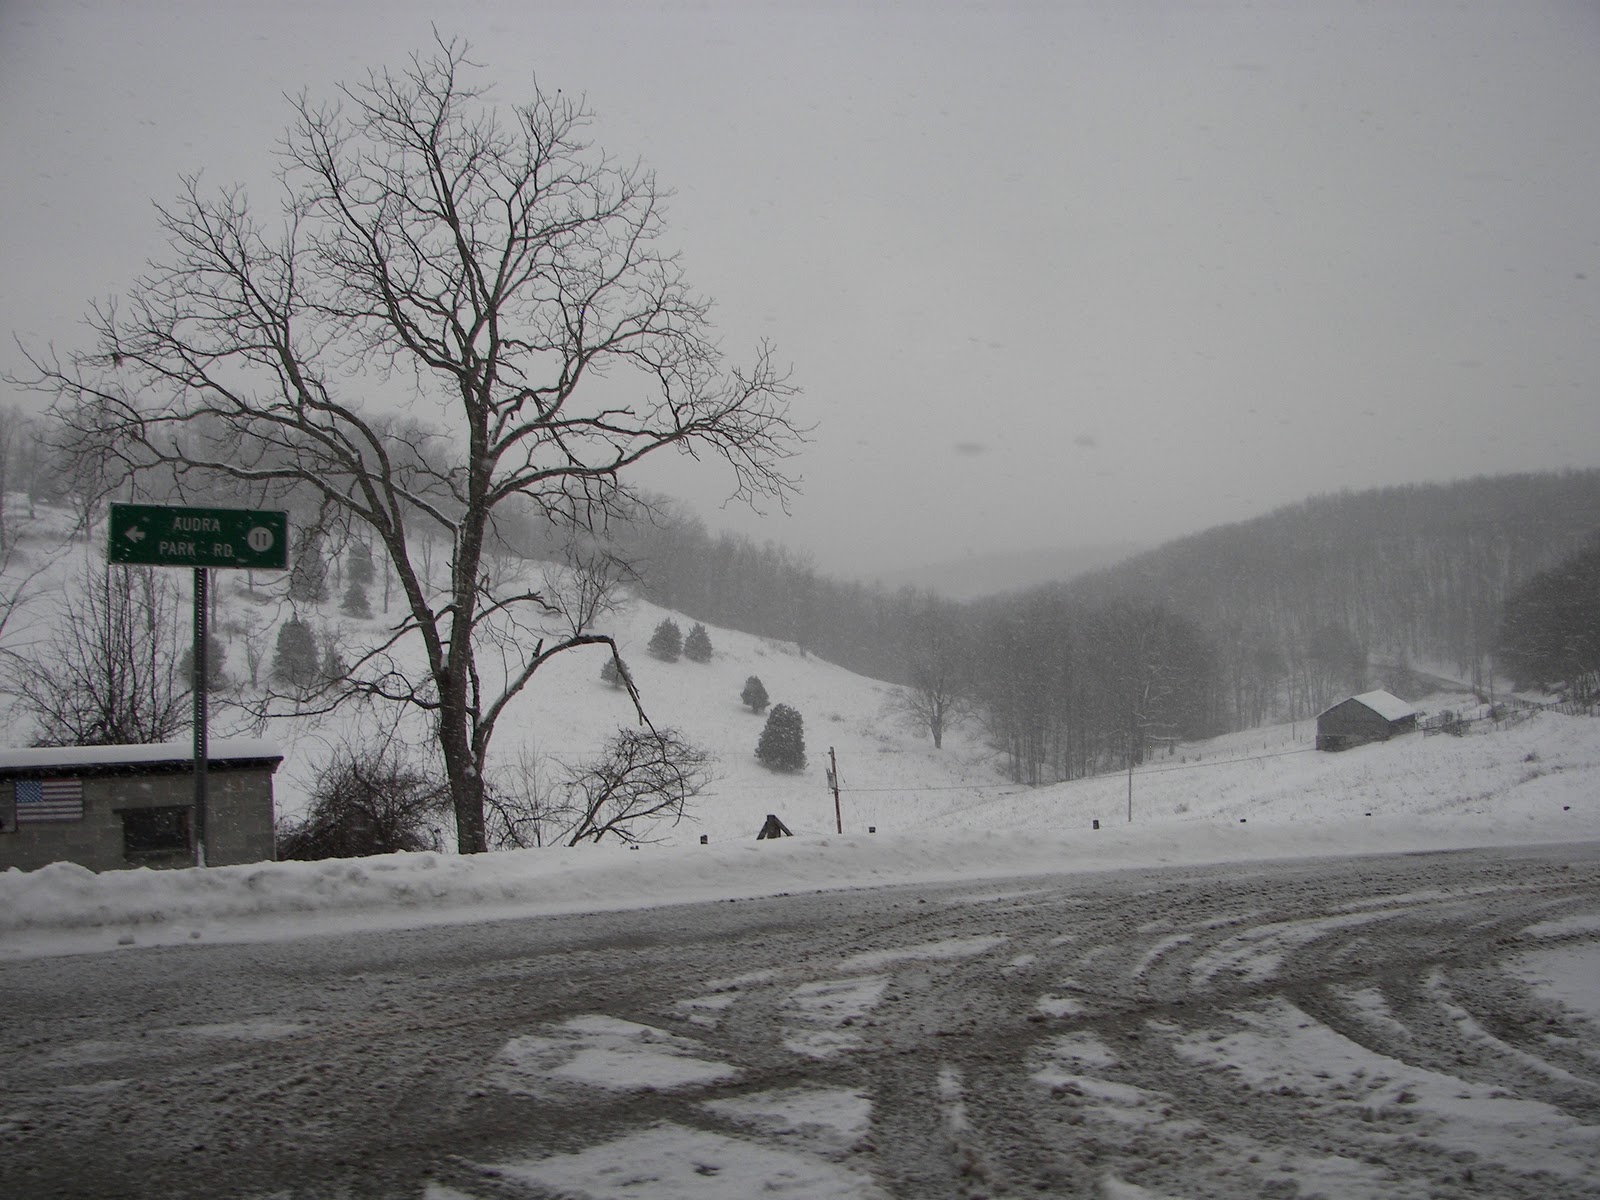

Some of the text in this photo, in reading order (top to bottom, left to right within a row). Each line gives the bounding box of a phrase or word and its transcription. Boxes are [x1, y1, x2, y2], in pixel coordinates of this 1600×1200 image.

[173, 517, 220, 532] AUDRA
[255, 532, 267, 546] 11
[159, 541, 196, 556] PARK
